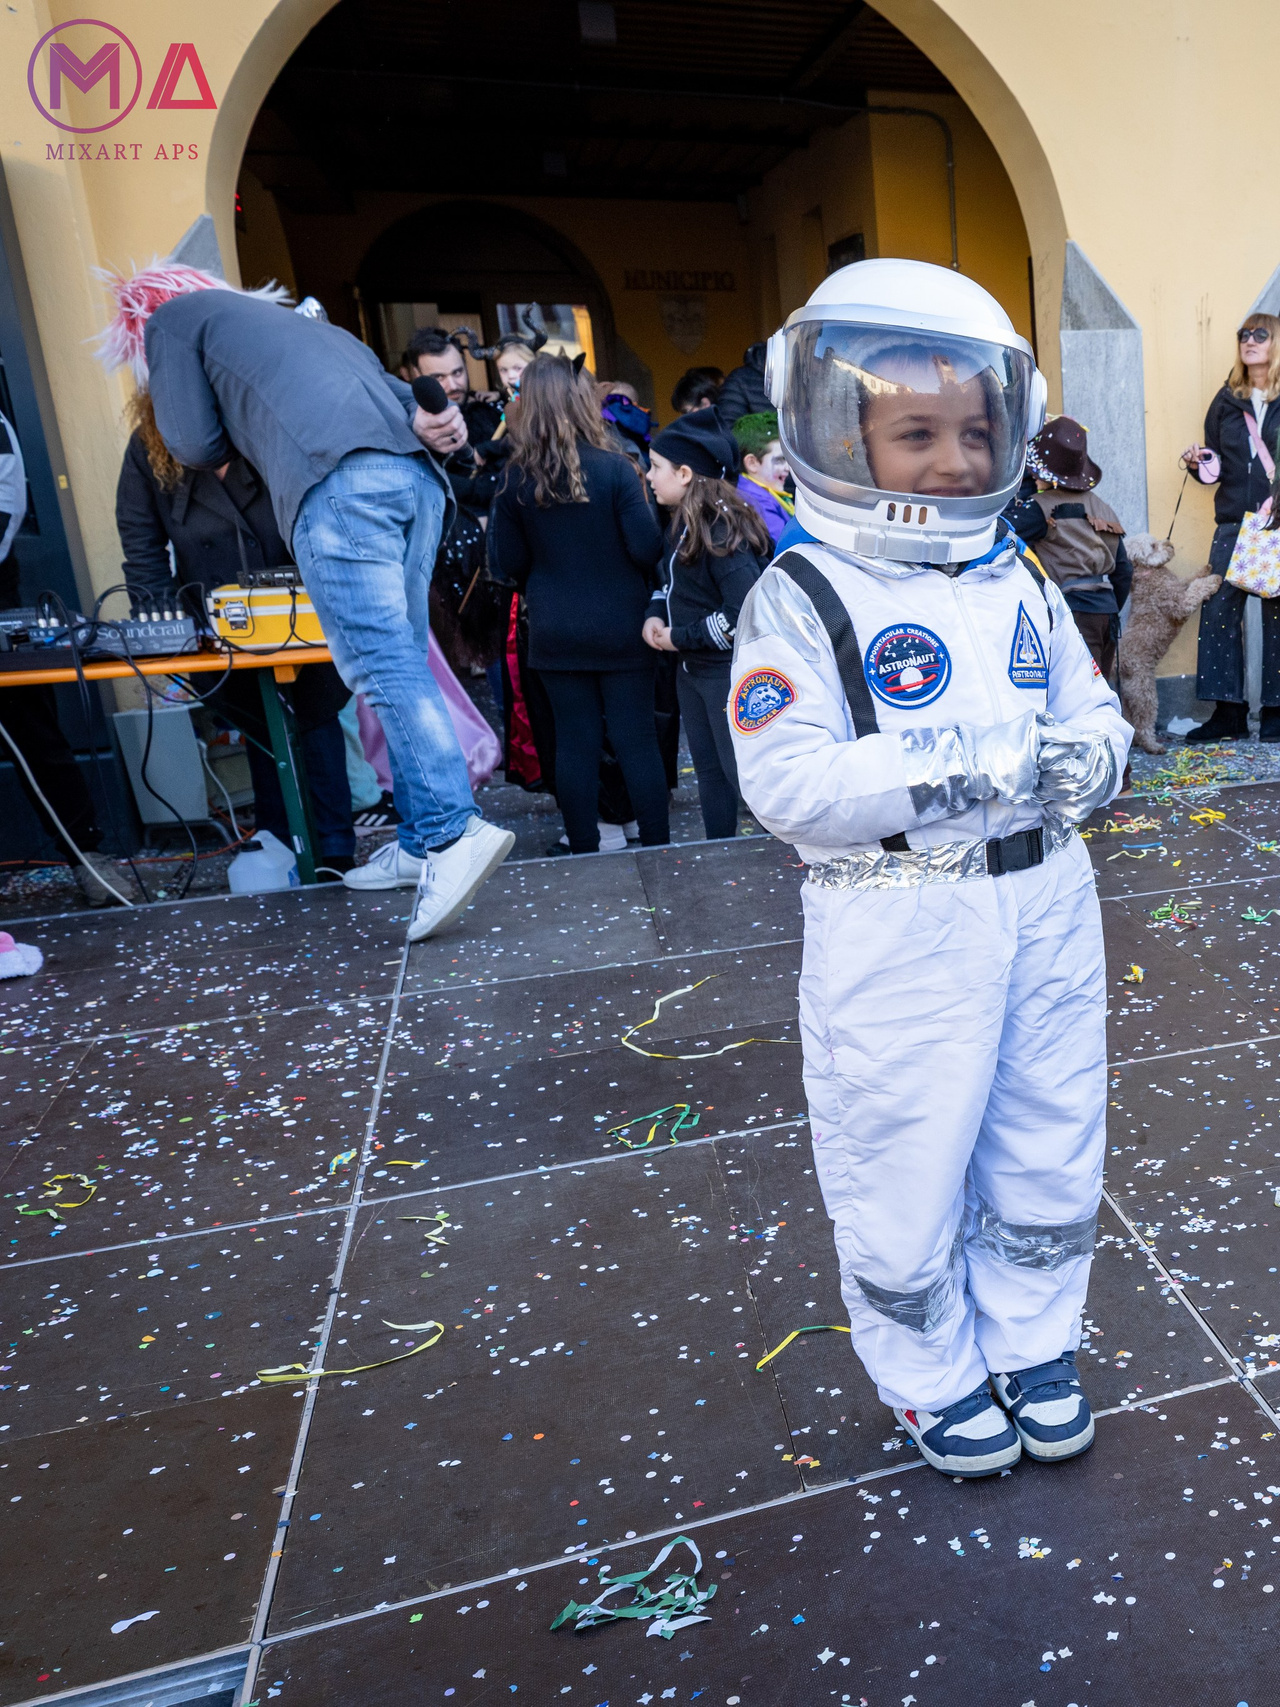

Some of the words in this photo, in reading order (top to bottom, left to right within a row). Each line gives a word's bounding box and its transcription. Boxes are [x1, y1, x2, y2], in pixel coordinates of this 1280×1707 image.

[869, 628, 905, 663] SPOOKTACULAR
[906, 627, 940, 648] CREATIONS
[879, 652, 936, 675] ASTRONAUT
[1011, 670, 1047, 679] ASTRONAUT
[740, 675, 786, 700] ASTRONAUT
